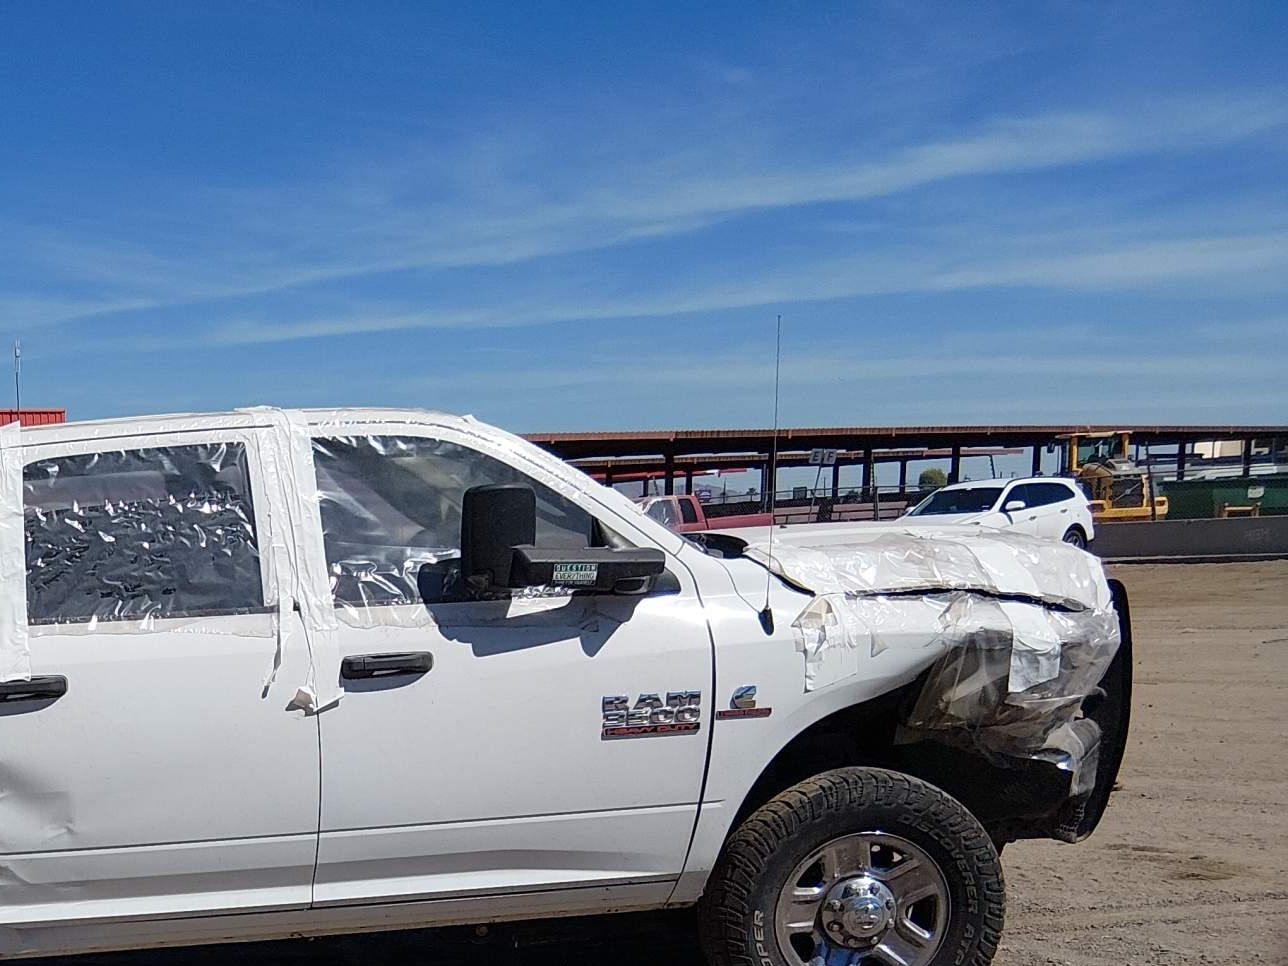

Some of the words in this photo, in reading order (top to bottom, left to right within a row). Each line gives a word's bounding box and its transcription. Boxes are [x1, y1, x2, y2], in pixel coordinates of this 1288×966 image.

[555, 572, 594, 580] EVERYTHING
[602, 691, 701, 712] RAM
[604, 726, 654, 736] HEAVY
[656, 722, 696, 733] DUTY
[898, 814, 978, 913] DISCOVERER
